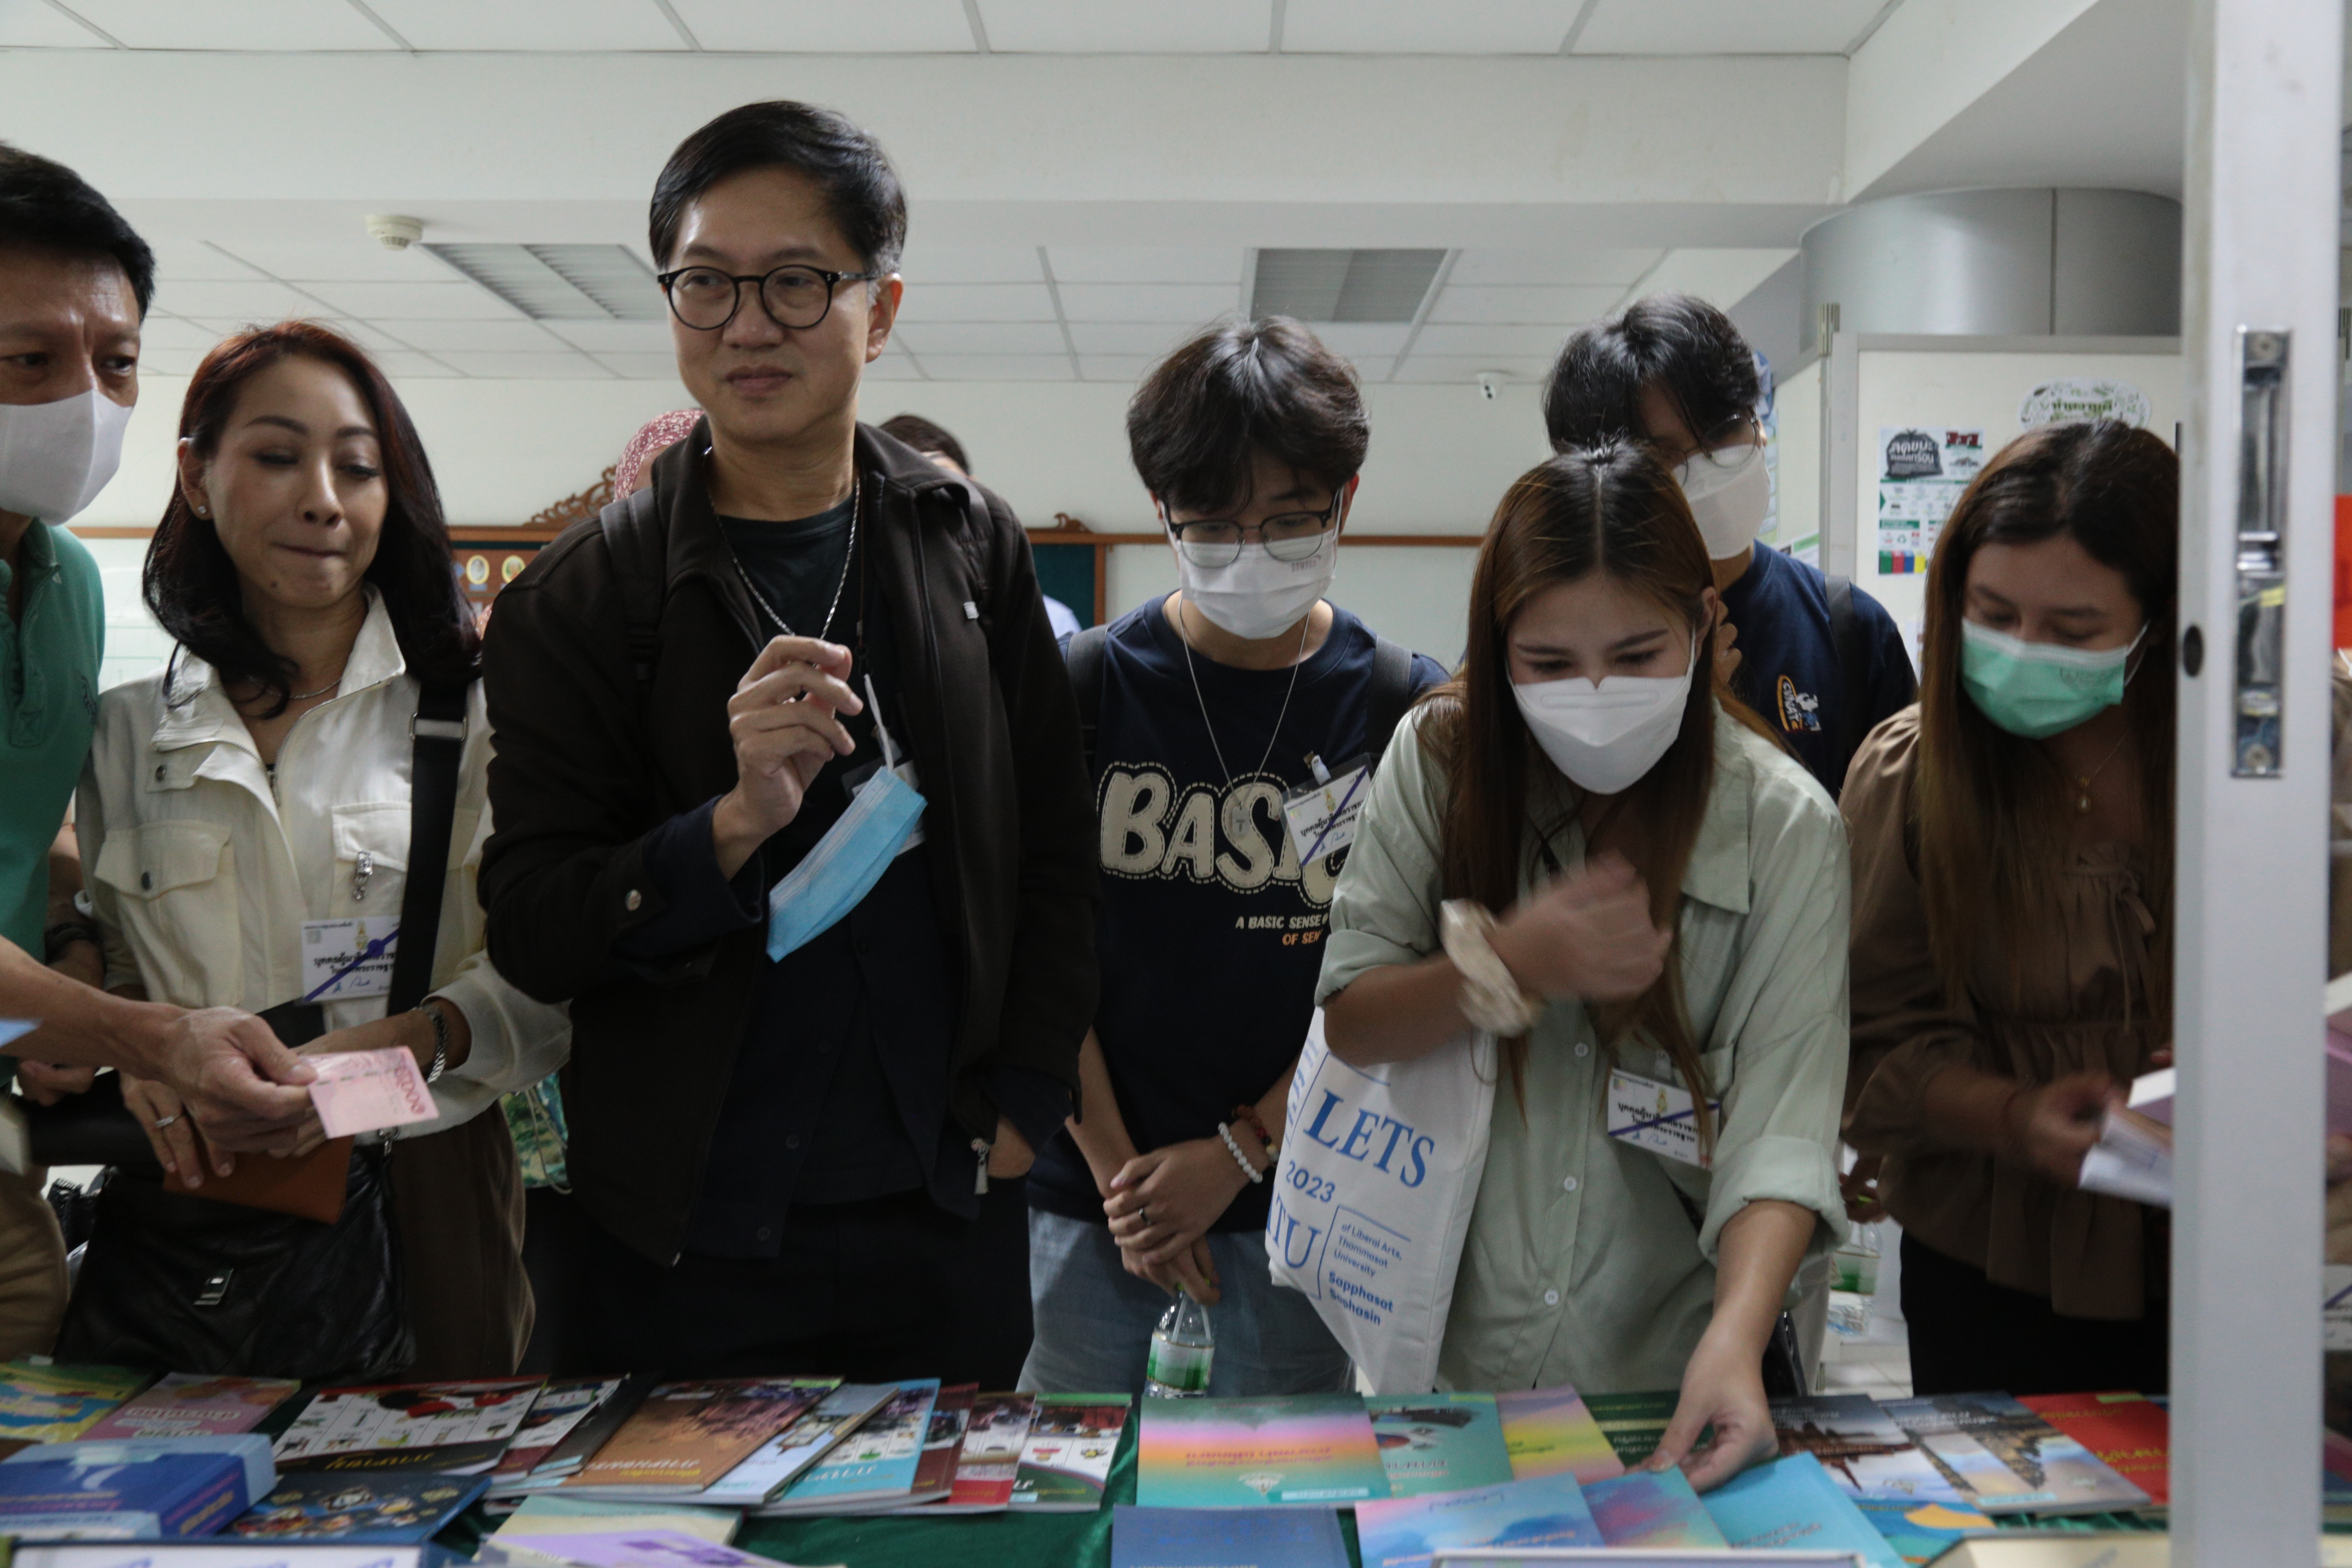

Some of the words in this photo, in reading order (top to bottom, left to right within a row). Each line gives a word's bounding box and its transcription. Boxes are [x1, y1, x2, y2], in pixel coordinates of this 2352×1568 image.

[1235, 916, 1244, 929] A
[1248, 916, 1285, 929] BASIC
[1289, 914, 1322, 929] SENSE
[1282, 933, 1299, 946] OF
[1302, 928, 1323, 944] SEN
[1303, 1088, 1435, 1188] LETS
[1286, 1160, 1335, 1203] 2023
[1339, 1234, 1388, 1268] Thammasat
[1341, 1223, 1351, 1233] of
[1352, 1225, 1381, 1249] Liberal
[1381, 1241, 1402, 1262] Arts,
[1334, 1247, 1375, 1279] University
[1329, 1271, 1393, 1313] Sapphasat
